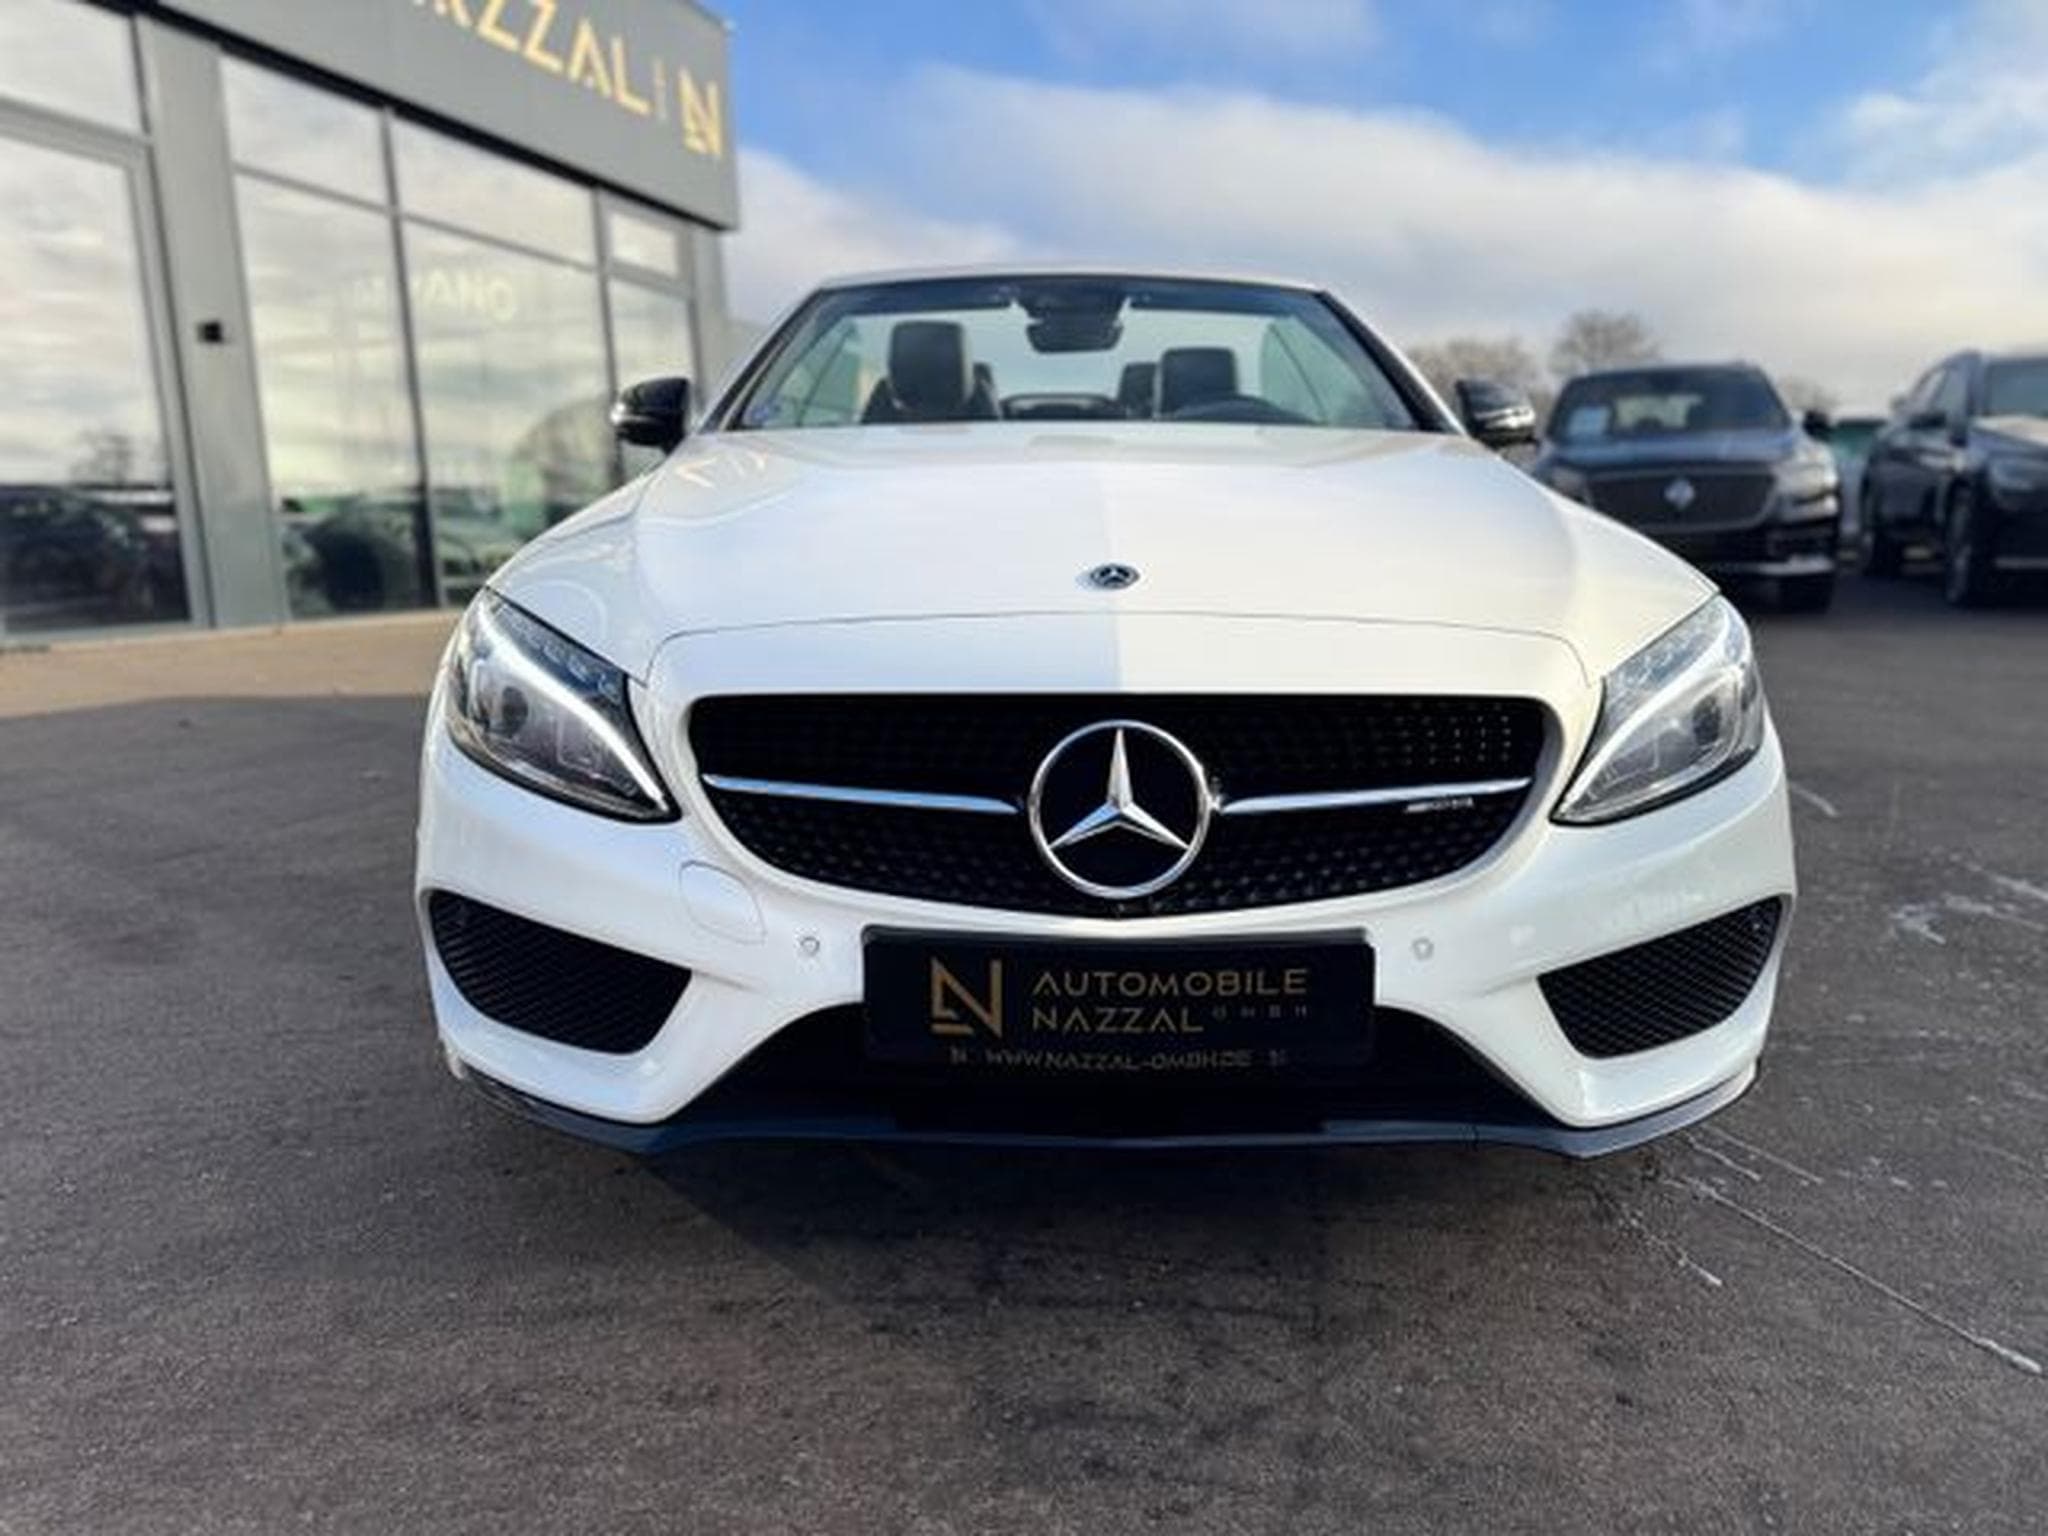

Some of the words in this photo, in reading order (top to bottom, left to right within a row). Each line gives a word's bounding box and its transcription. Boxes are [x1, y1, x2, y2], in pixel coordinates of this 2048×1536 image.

[408, 0, 652, 115] ZZAL
[1032, 968, 1308, 998] AUTOMOBILE
[1032, 1006, 1204, 1034] NAZZAL
